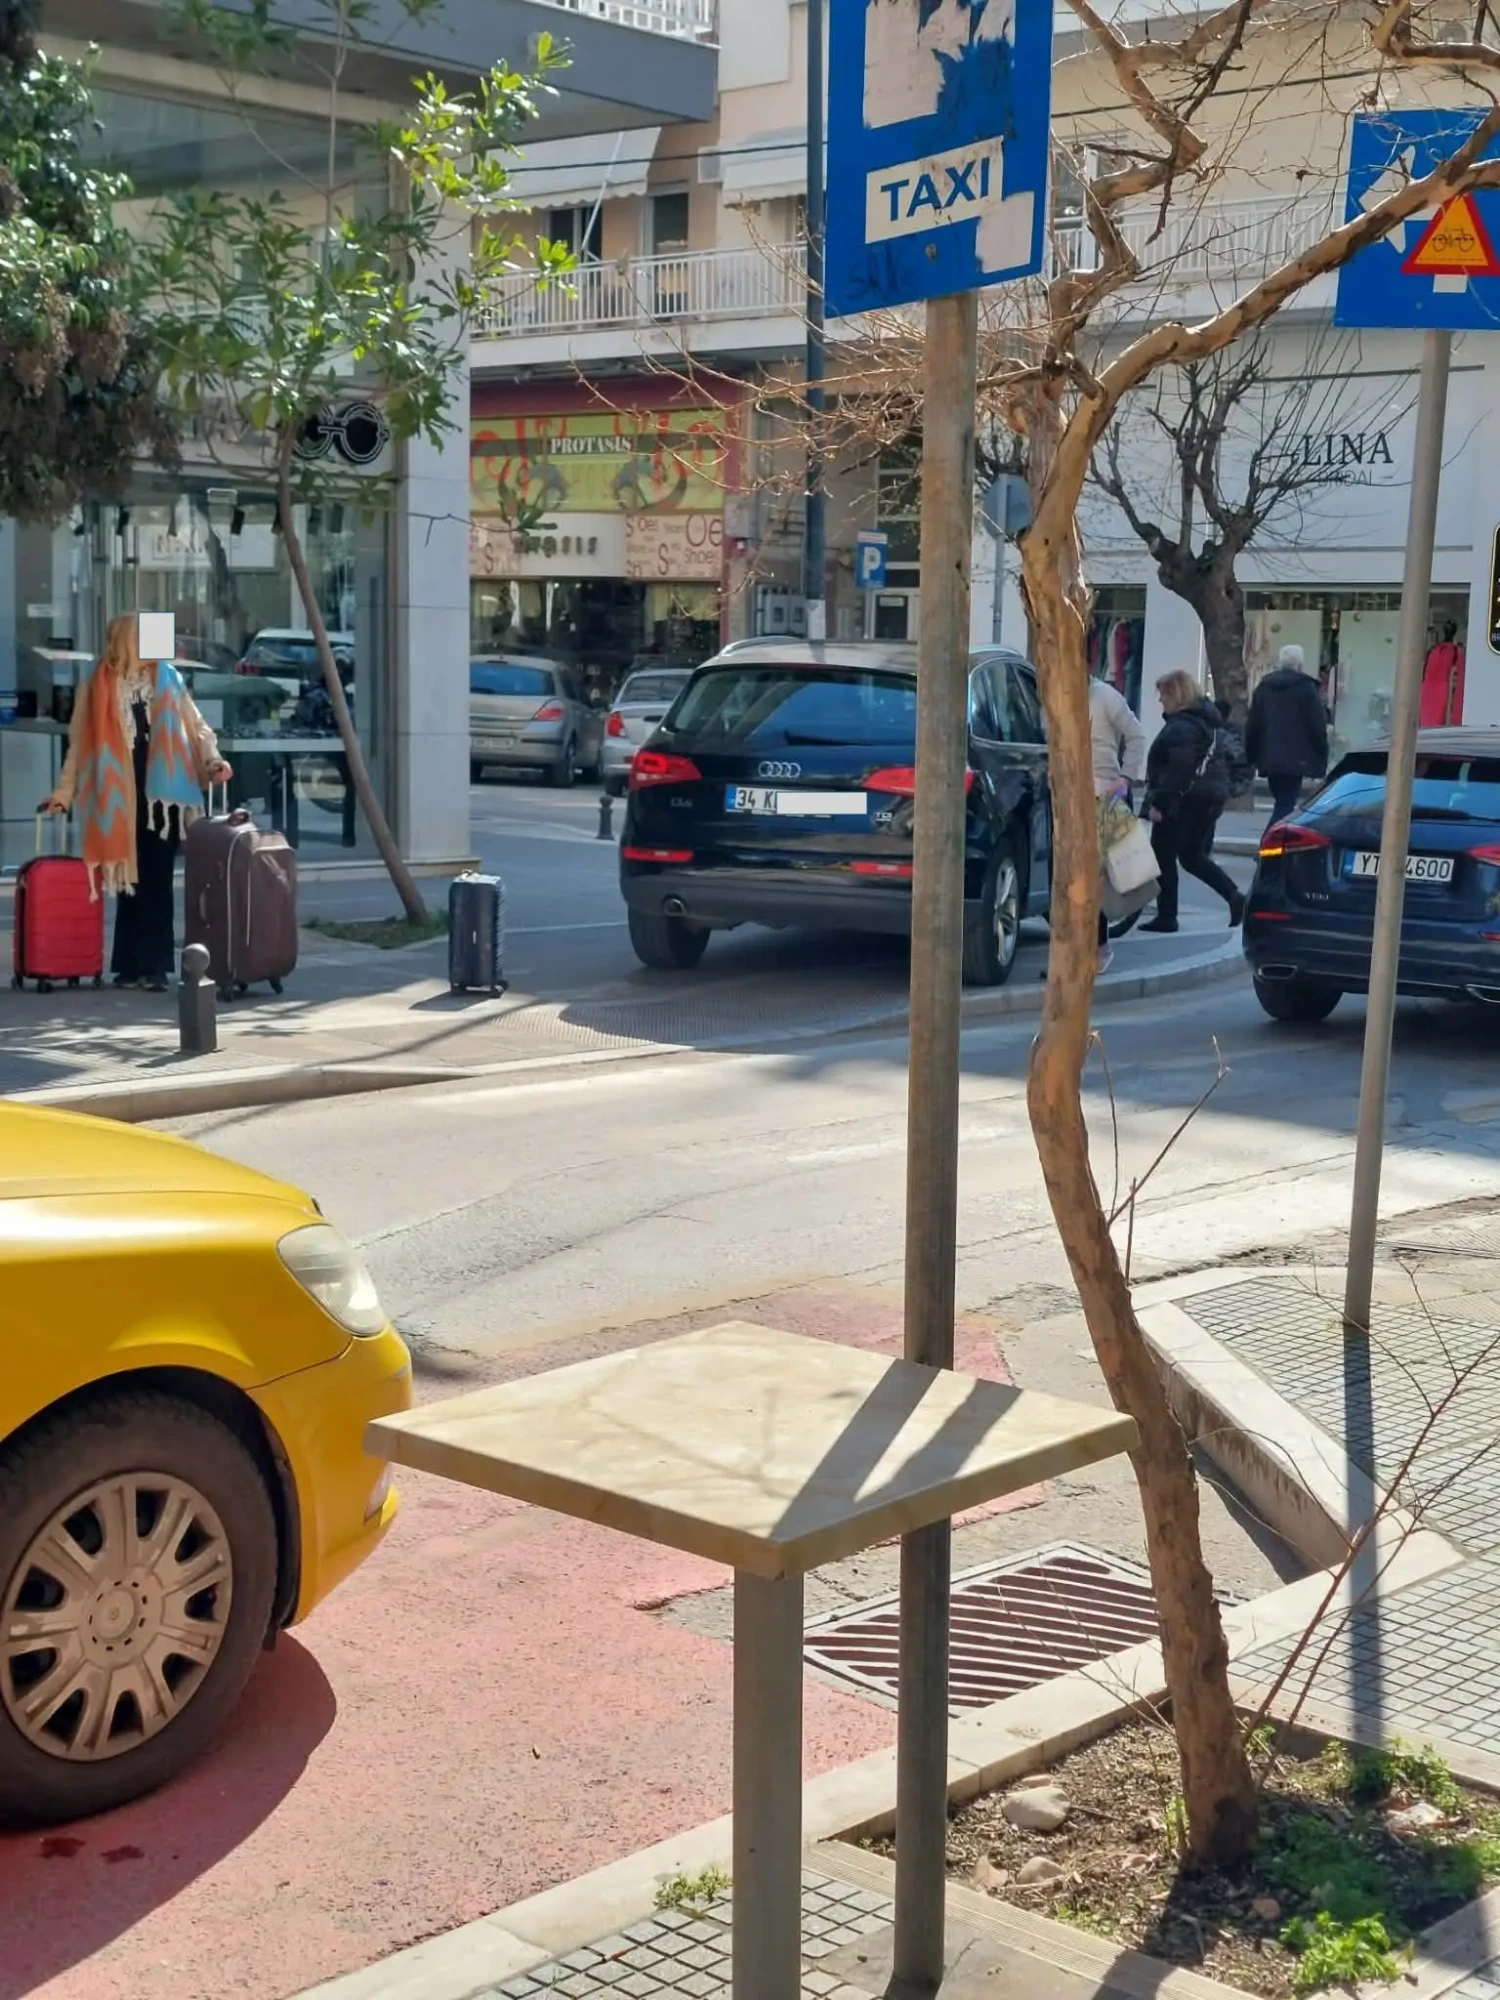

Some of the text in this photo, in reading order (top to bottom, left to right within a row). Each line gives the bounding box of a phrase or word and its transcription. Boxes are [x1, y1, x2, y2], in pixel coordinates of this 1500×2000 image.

[881, 156, 990, 222] TAXI
[550, 436, 632, 454] PROTASIS
[1302, 432, 1393, 466] LINA
[862, 546, 882, 580] P
[737, 788, 756, 808] 34
[1361, 853, 1451, 879] YT 4600
